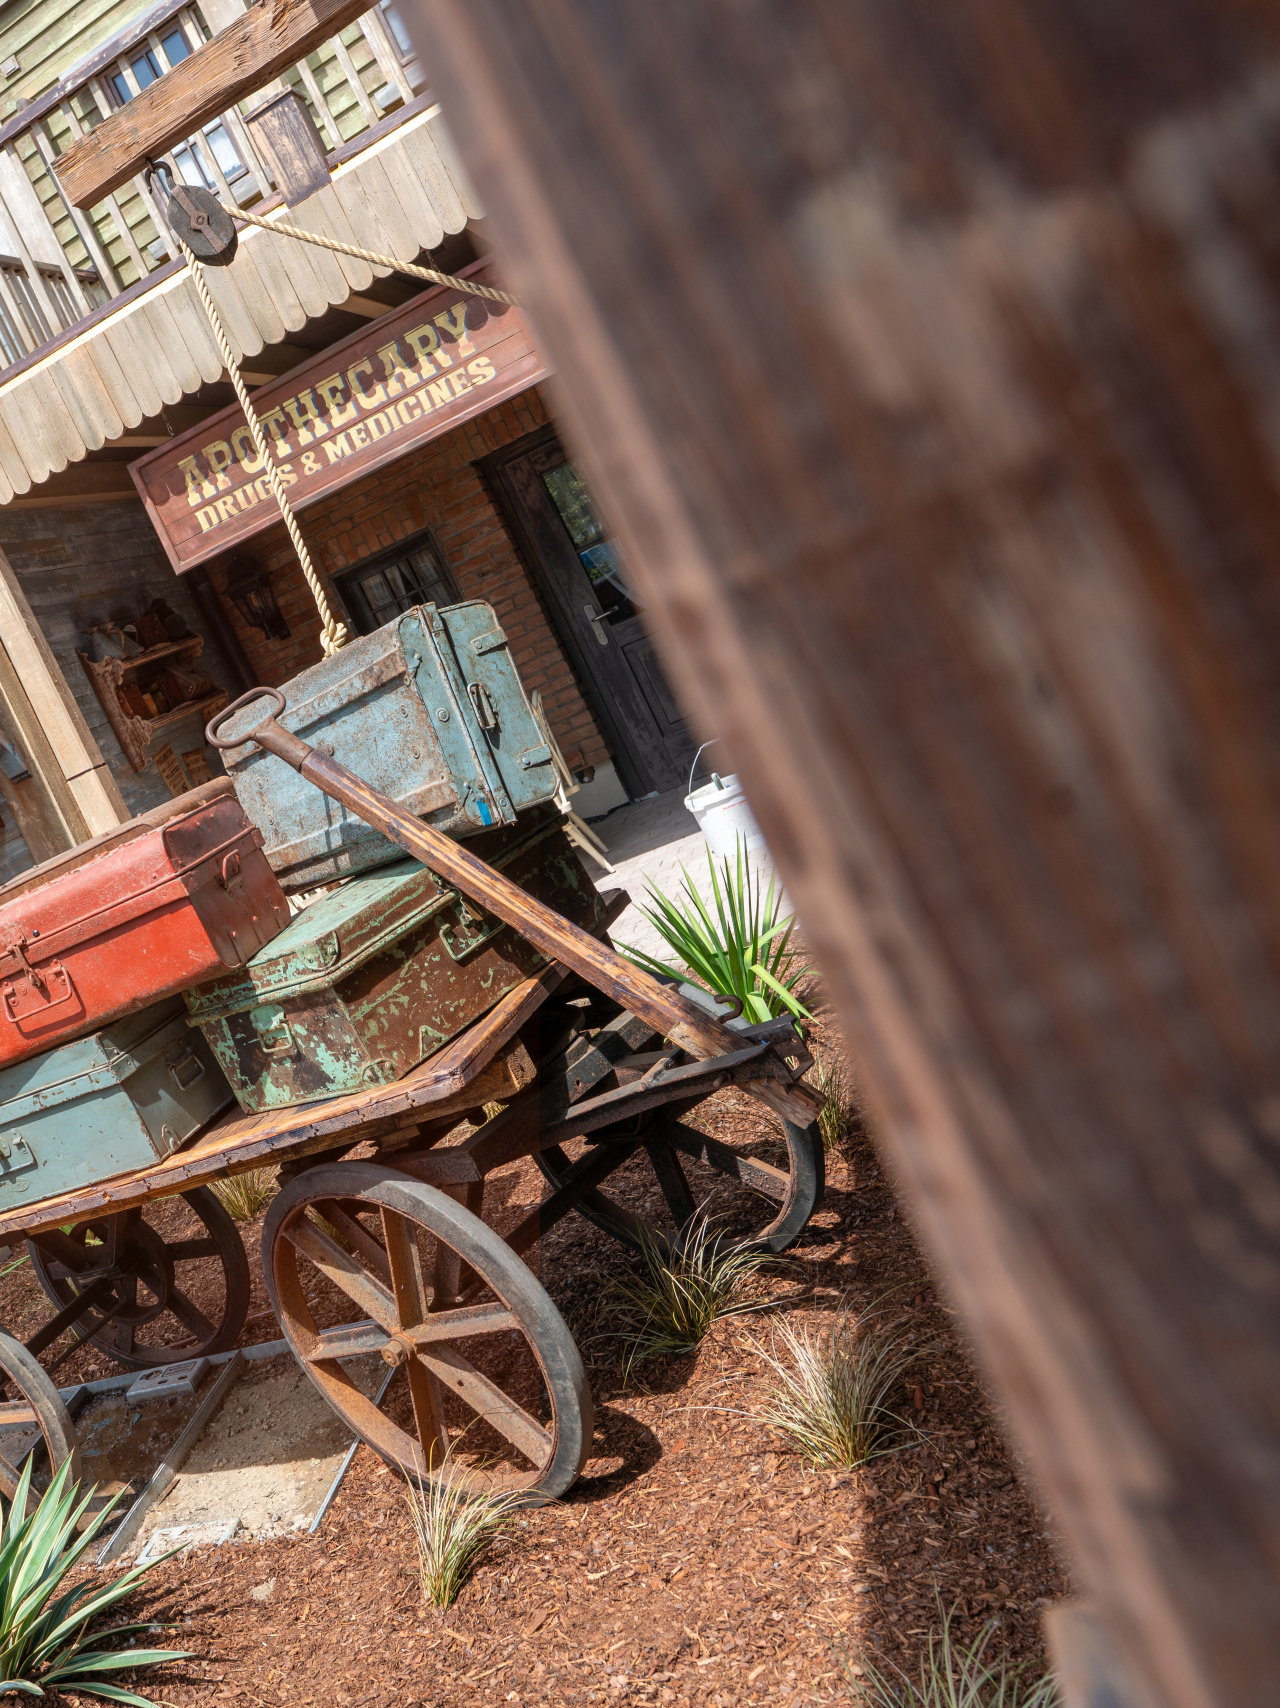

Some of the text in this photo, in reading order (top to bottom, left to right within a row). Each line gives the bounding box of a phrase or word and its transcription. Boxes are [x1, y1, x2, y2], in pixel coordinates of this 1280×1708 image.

[177, 301, 478, 507] APOTHECARY
[194, 356, 497, 533] DRUGS & MEDICINES
